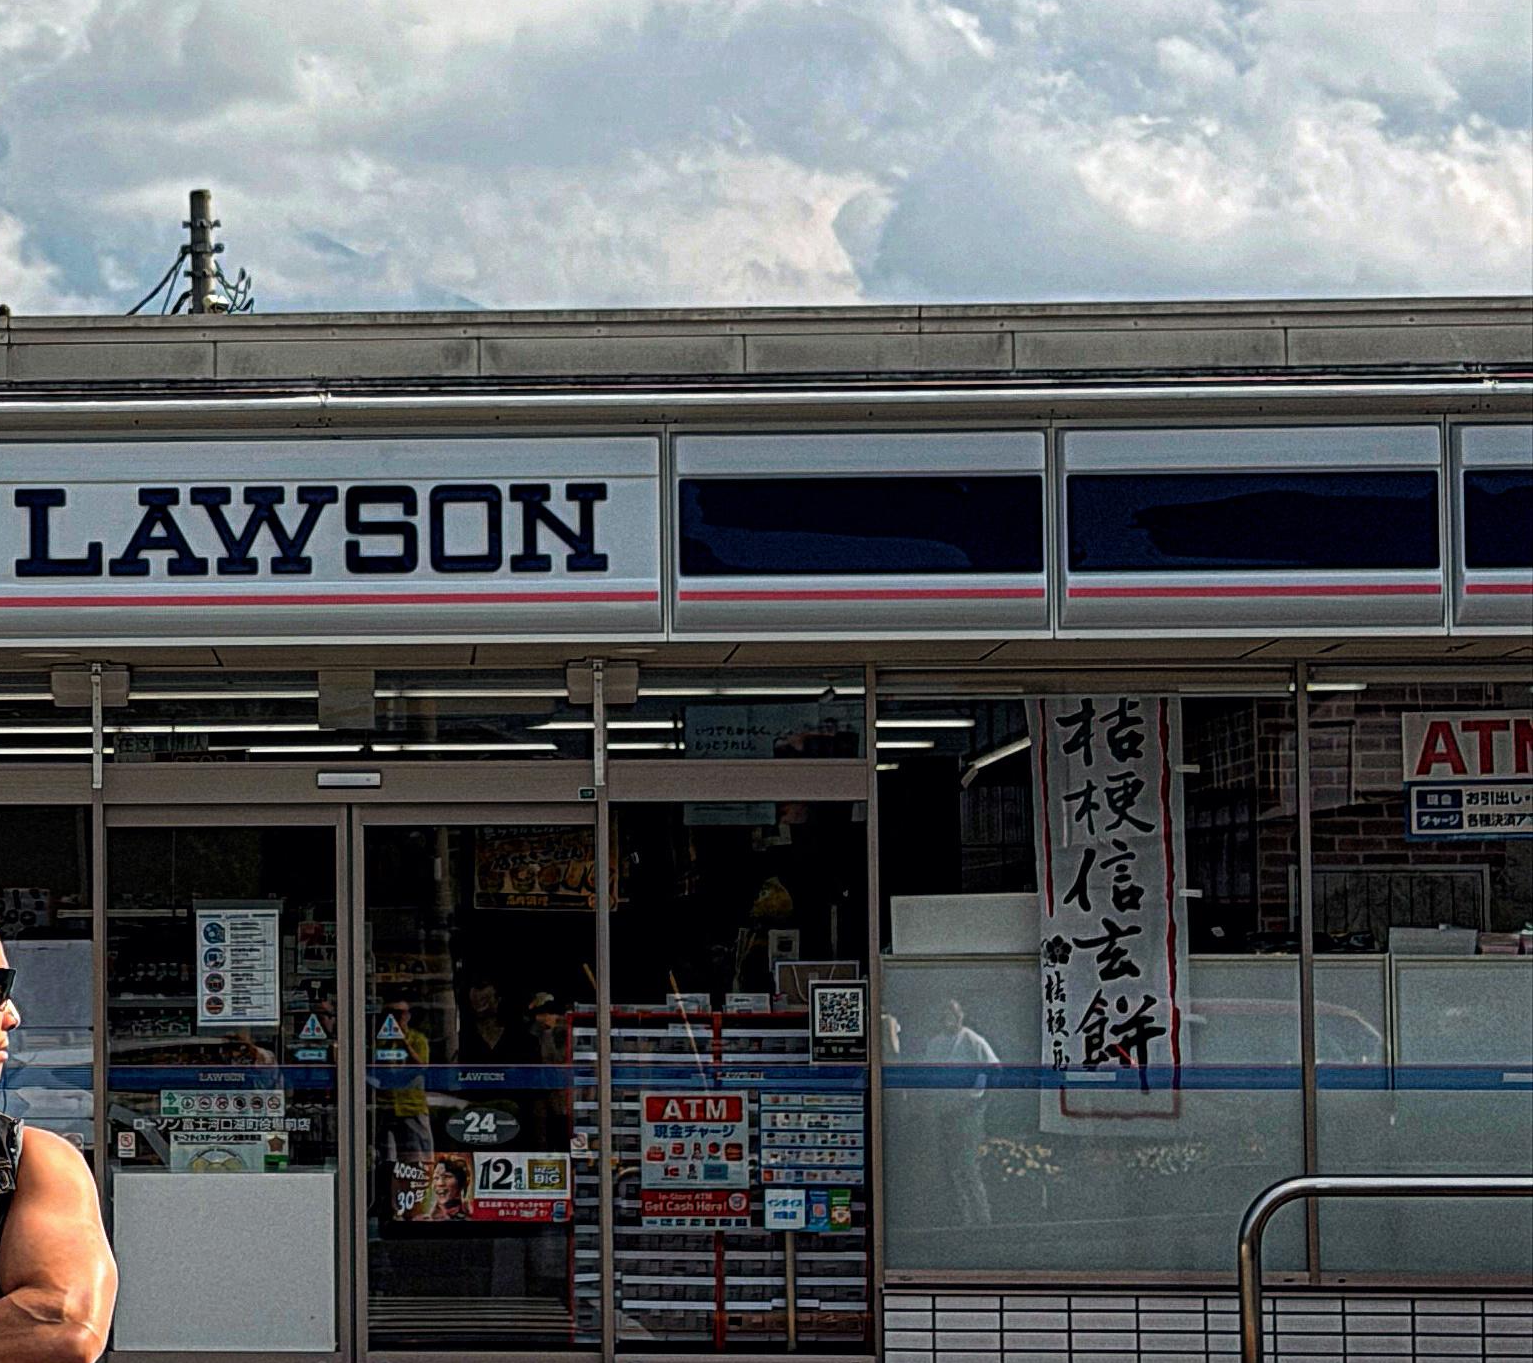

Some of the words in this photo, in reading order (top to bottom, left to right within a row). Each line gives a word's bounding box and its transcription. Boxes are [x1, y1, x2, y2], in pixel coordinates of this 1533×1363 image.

[14, 483, 608, 578] LAWSON
[1055, 698, 1167, 1095] 桔梗信玄餅
[198, 1073, 246, 1082] LAWSON
[458, 1072, 505, 1081] LAWSON
[662, 1099, 727, 1120] ATM
[465, 1111, 496, 1133] 24
[654, 1124, 736, 1139] 現金チャージ
[534, 1173, 561, 1185] BIG
[644, 1200, 664, 1213] Get
[666, 1200, 694, 1213] Cash
